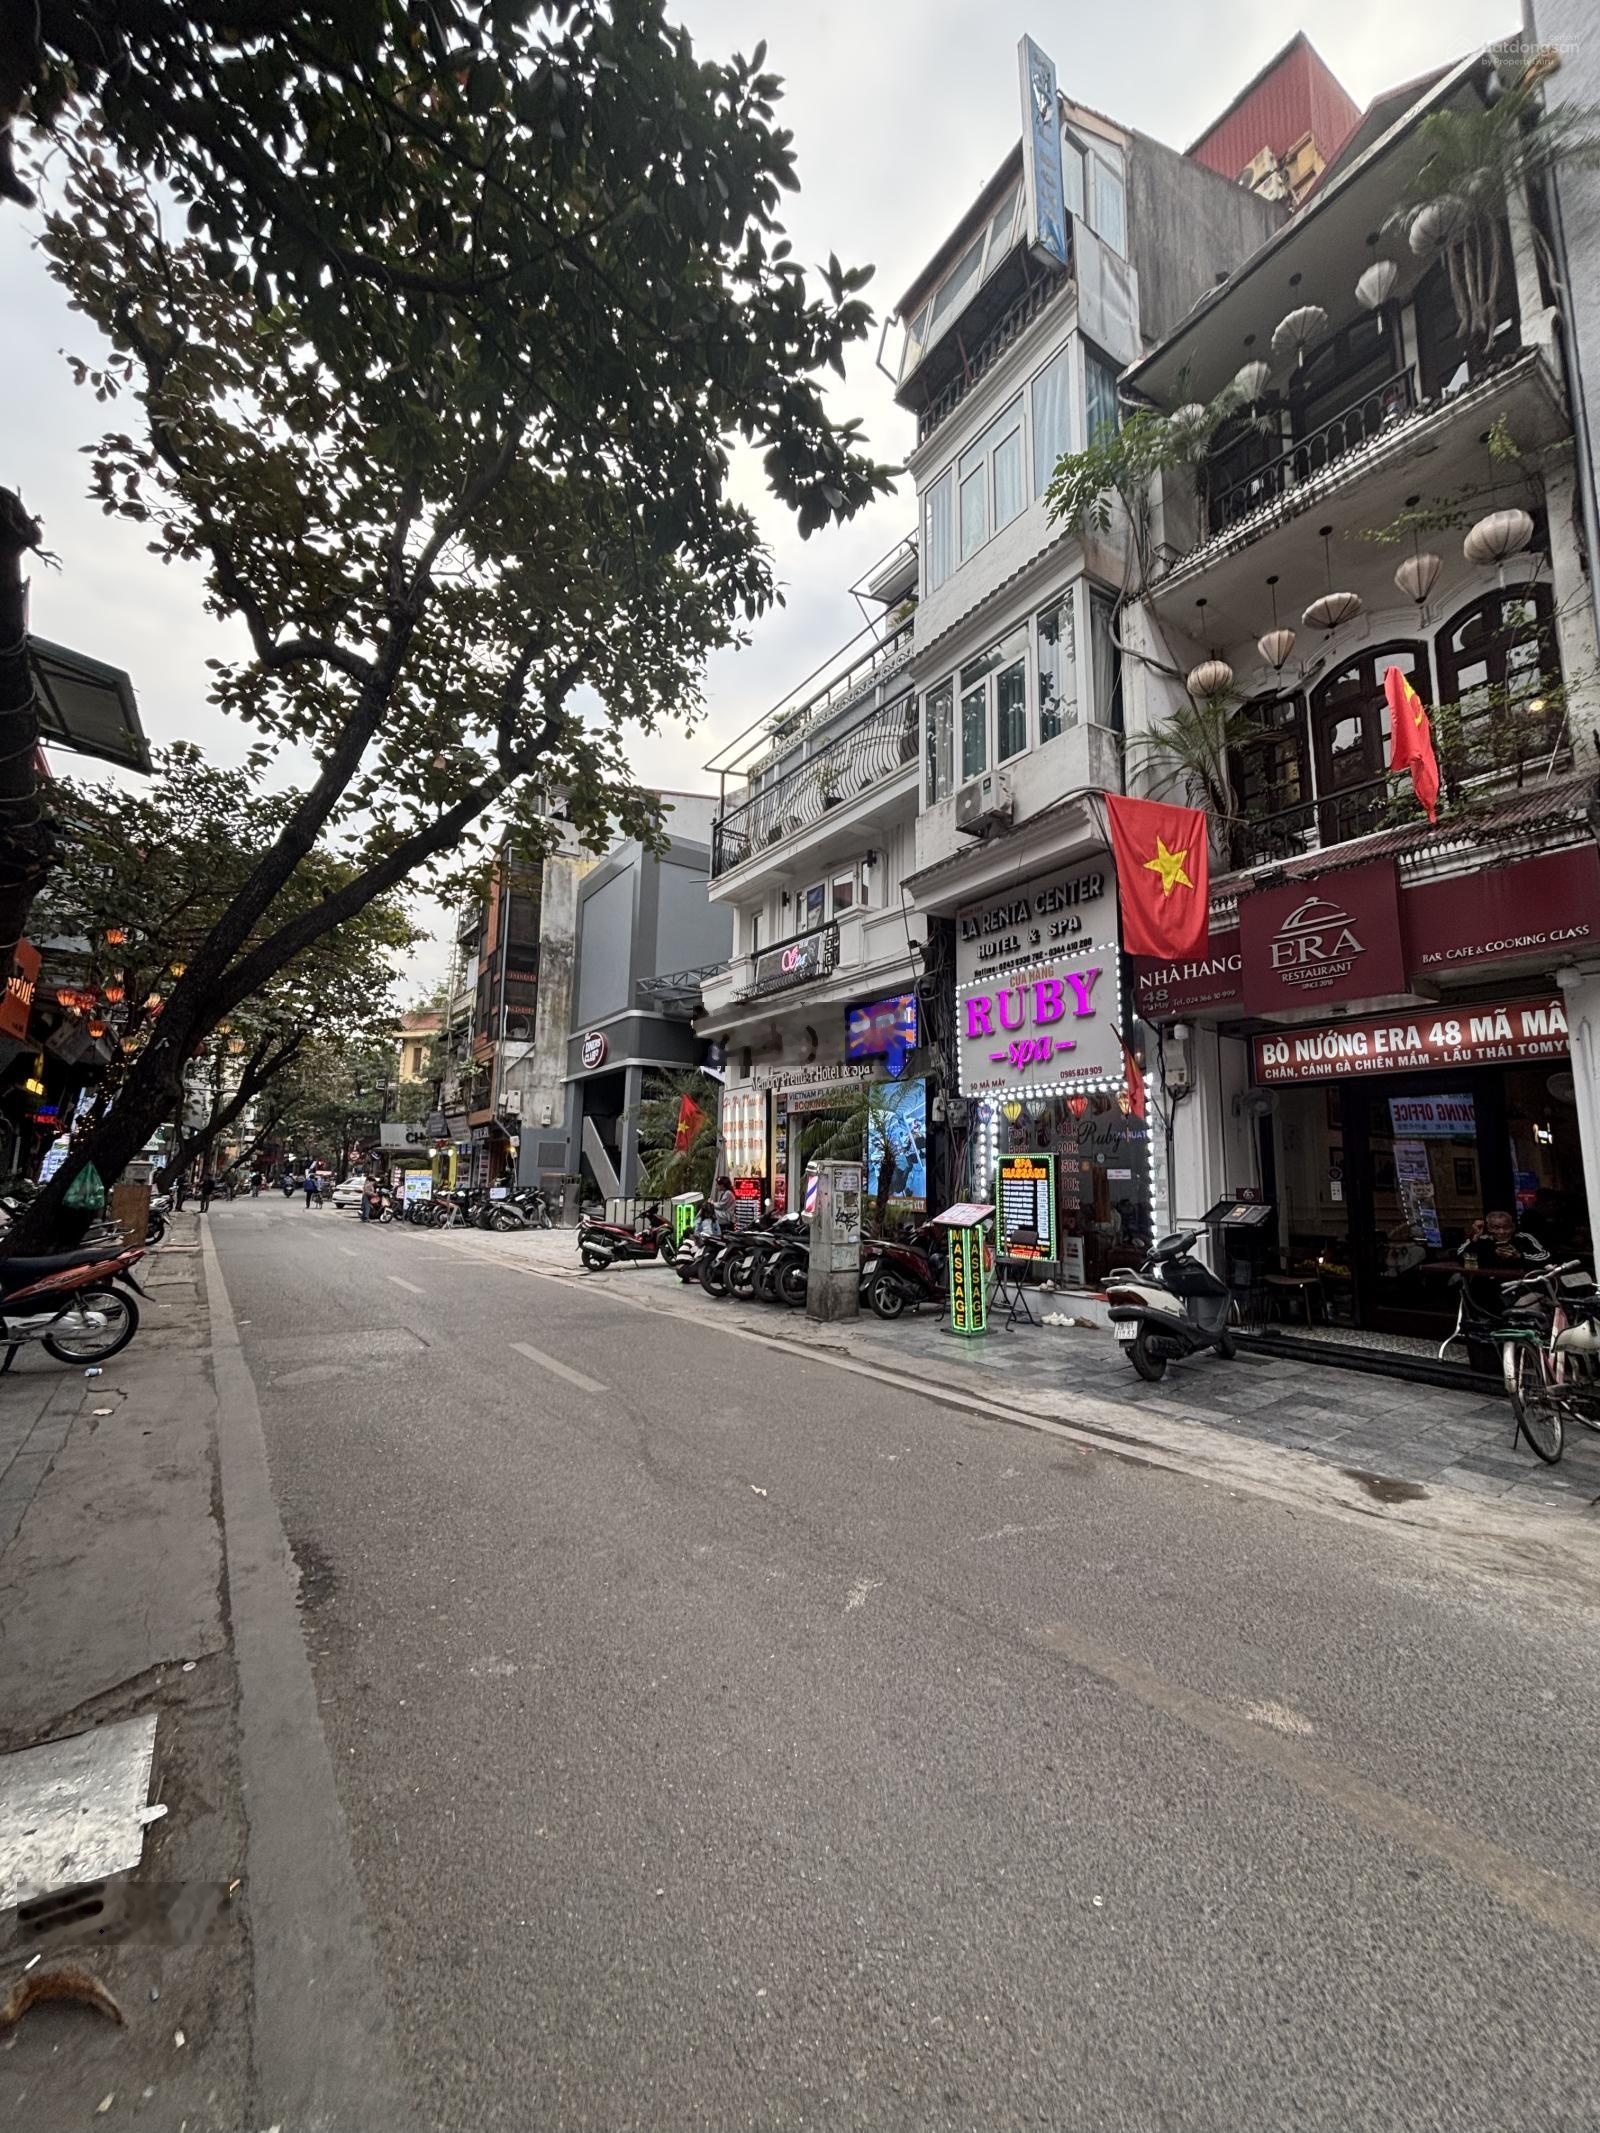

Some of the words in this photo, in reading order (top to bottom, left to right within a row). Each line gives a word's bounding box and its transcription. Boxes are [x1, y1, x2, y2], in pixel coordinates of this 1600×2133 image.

[960, 916, 981, 941] LA
[982, 900, 1031, 933] RENTA
[1034, 874, 1104, 914] CENTER
[977, 935, 1020, 959] HOTEL
[1027, 929, 1040, 944] &
[1048, 915, 1082, 937] SPA
[1269, 928, 1367, 969] ERA
[1422, 952, 1442, 964] BAR
[1446, 946, 1475, 960] CAFE
[1485, 932, 1546, 953] COOKING
[1549, 924, 1590, 941] CLASS
[1140, 963, 1181, 990] NHÀ
[1281, 961, 1353, 982] RESTAURANT
[965, 967, 1103, 1038] RUBY
[1143, 989, 1169, 1002] 48
[1262, 1036, 1290, 1066] BÒ
[1295, 1029, 1368, 1062] NƯỚNG
[1373, 1025, 1422, 1053] ERA
[1428, 1020, 1462, 1047] 48
[1469, 1007, 1514, 1043] MÃ
[1520, 1000, 1569, 1037] MÂ
[752, 1074, 781, 1092] Memory
[815, 1065, 840, 1081] Hotel
[1301, 1061, 1332, 1076] CÁNH
[1335, 1059, 1352, 1073] GÀ
[1355, 1056, 1394, 1071] CHIÊN
[1475, 1043, 1513, 1059] THÁI
[788, 1090, 816, 1101] VIETNAM
[1077, 1120, 1123, 1152] Ruby
[952, 1229, 965, 1326] MASSAGE
[971, 1229, 983, 1326] MASSAGE
